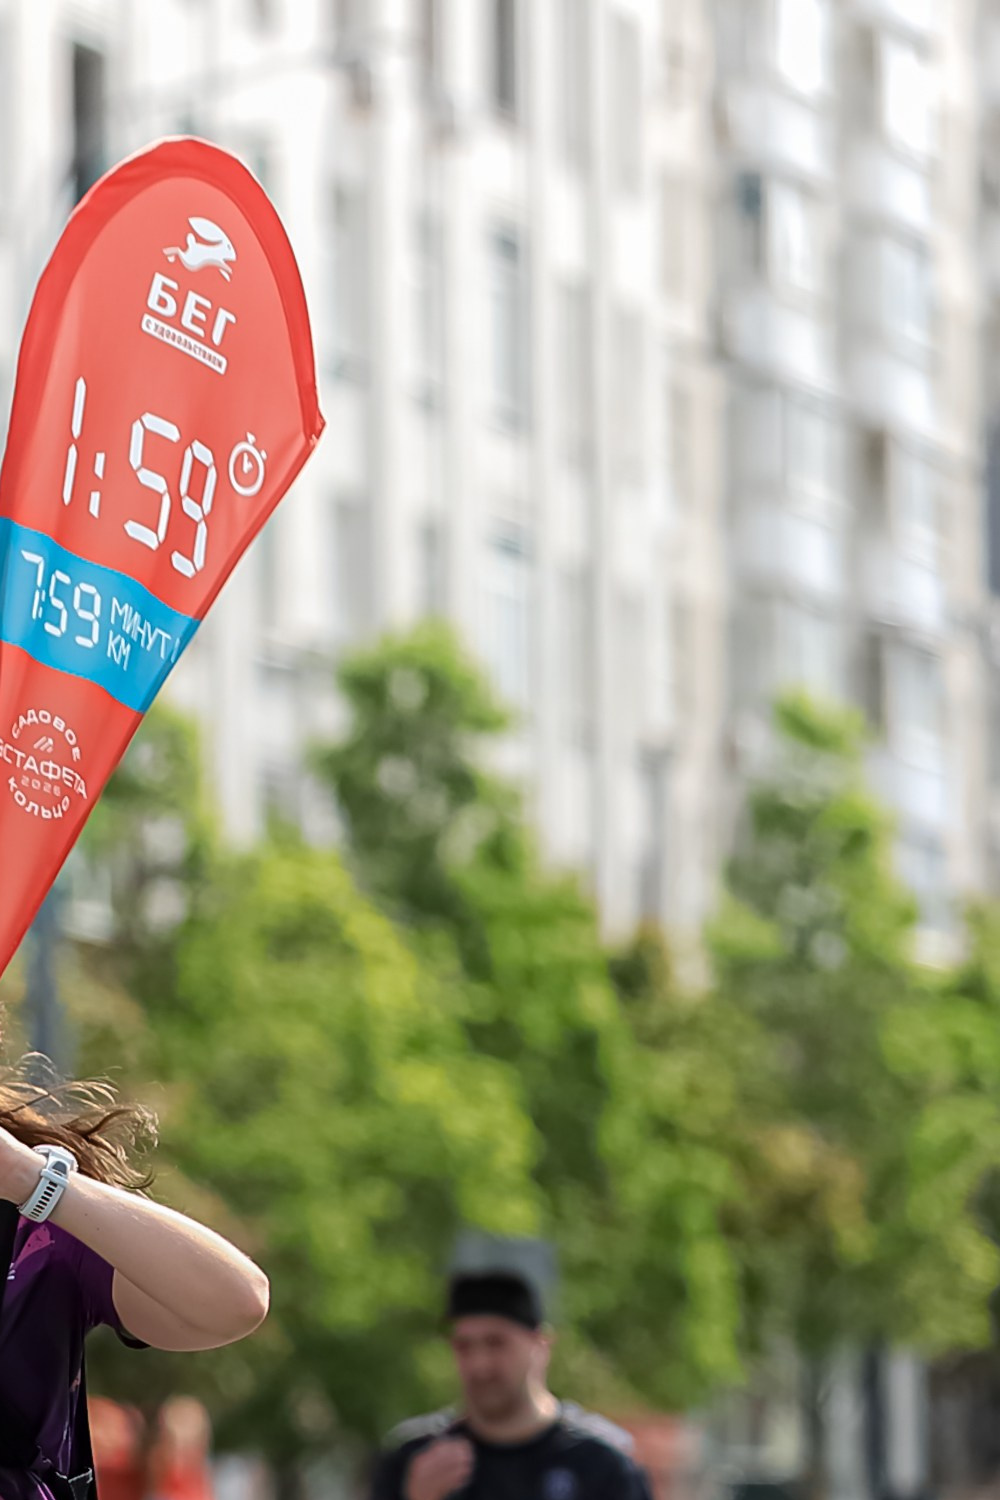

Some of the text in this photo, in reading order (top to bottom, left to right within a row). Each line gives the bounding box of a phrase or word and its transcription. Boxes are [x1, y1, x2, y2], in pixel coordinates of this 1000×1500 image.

[147, 272, 236, 346] БЕГ
[63, 376, 217, 578] 1:59
[21, 550, 101, 648] 7:59
[106, 630, 131, 671] КМ
[11, 708, 81, 763] САДОВОЕ
